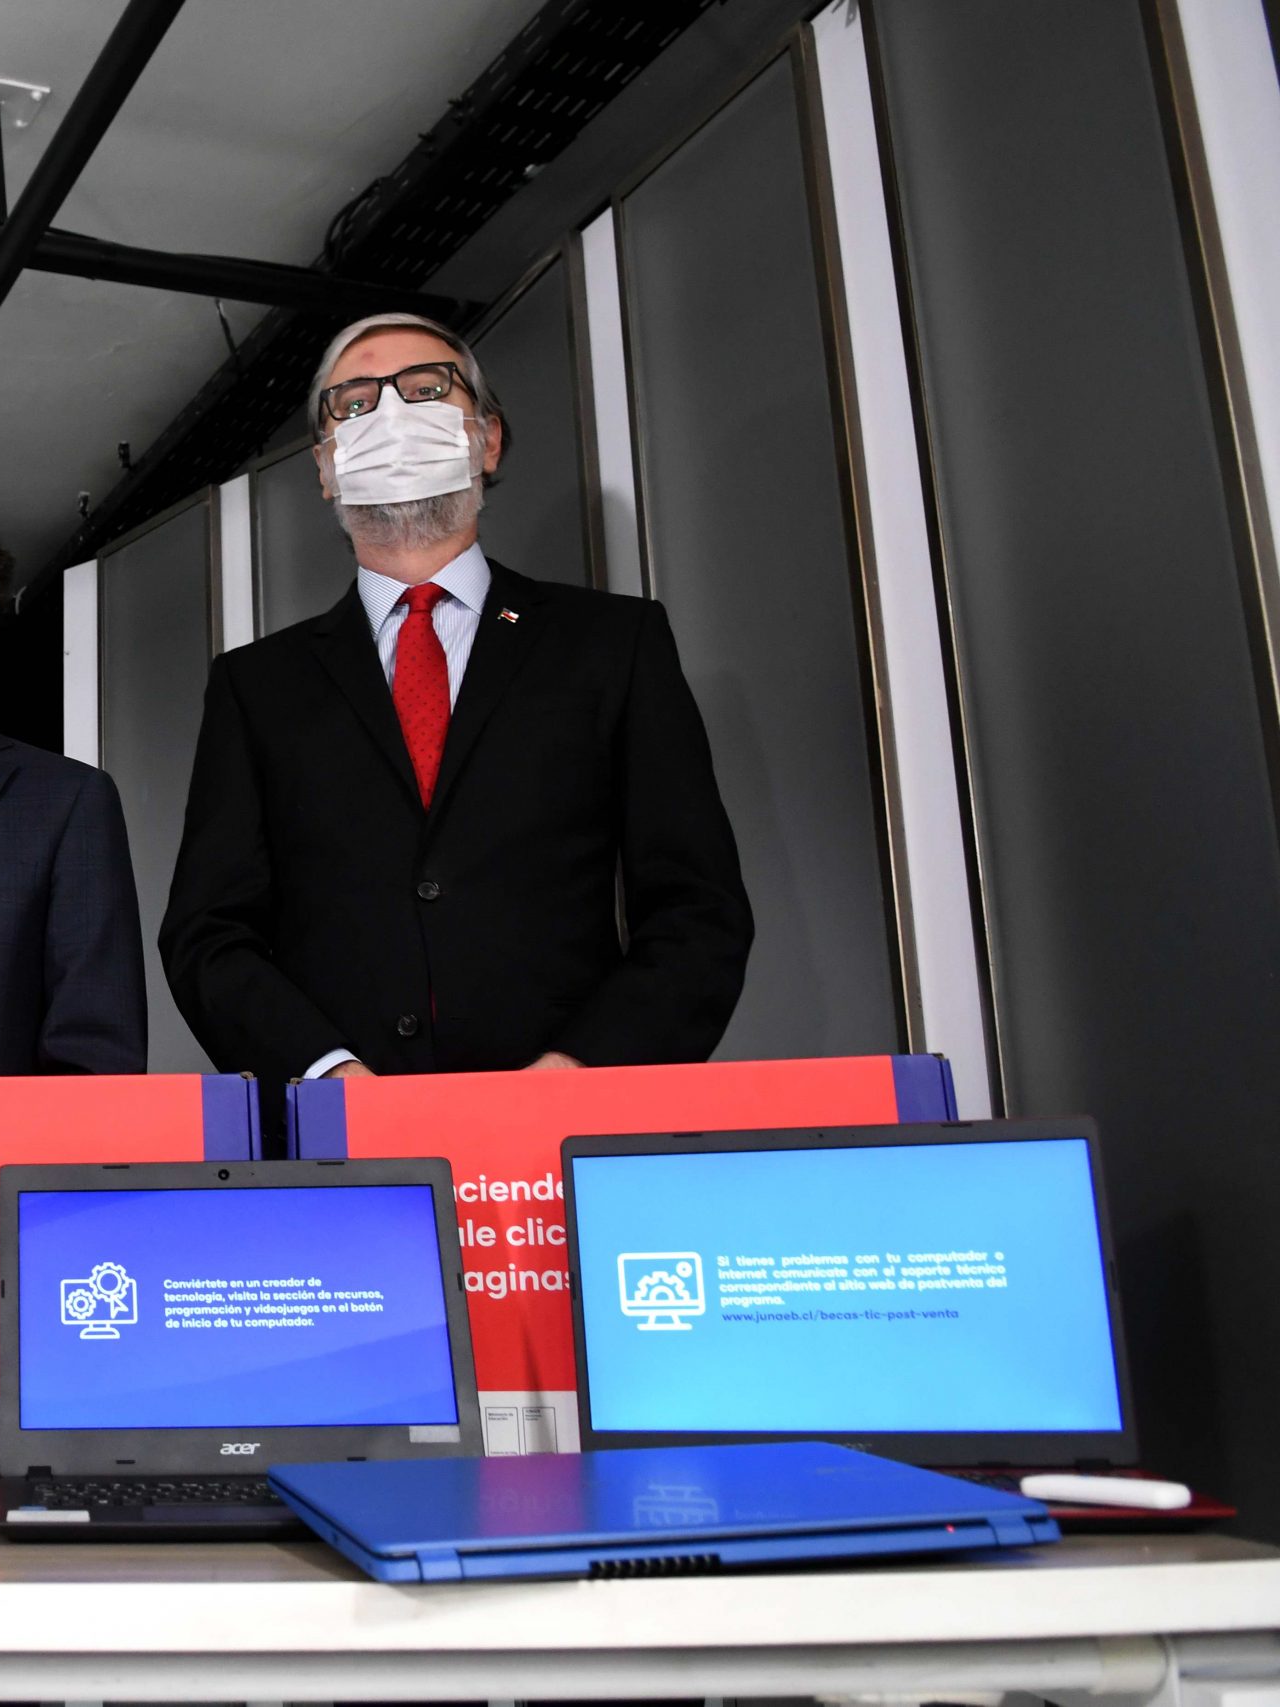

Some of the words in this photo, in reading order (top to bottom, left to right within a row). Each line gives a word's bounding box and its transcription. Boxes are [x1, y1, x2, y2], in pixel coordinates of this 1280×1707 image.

[506, 1217, 567, 1246] clic
[735, 1255, 775, 1266] tienes
[781, 1254, 849, 1268] problemas
[855, 1254, 880, 1264] con
[885, 1252, 901, 1263] tu
[907, 1250, 988, 1264] computador
[994, 1251, 1005, 1261] o
[852, 1267, 878, 1277] con
[882, 1265, 895, 1277] el
[900, 1264, 951, 1278] soporte
[956, 1263, 1006, 1275] técnico
[163, 1278, 228, 1289] Conviértete
[230, 1279, 244, 1288] en
[246, 1279, 260, 1288] un
[262, 1277, 306, 1288] creador
[307, 1276, 322, 1287] de
[719, 1280, 821, 1294] correspondiente
[823, 1279, 836, 1291] al
[838, 1278, 866, 1291] sitio
[868, 1278, 896, 1290] web
[897, 1278, 915, 1290] de
[917, 1277, 984, 1291] postventa
[986, 1276, 1008, 1288] del
[228, 1290, 258, 1301] visita
[260, 1290, 271, 1301] la
[272, 1289, 315, 1301] sección
[317, 1289, 331, 1300] de
[333, 1290, 384, 1301] recursos,
[720, 1295, 786, 1308] programa.
[164, 1304, 242, 1317] programación
[244, 1306, 251, 1316] y
[253, 1303, 320, 1316] videojuegos
[322, 1304, 336, 1313] en
[338, 1302, 349, 1312] el
[350, 1301, 384, 1312] botón
[165, 1318, 180, 1328] de
[182, 1317, 212, 1328] inicio
[213, 1317, 229, 1328] de
[230, 1318, 243, 1327] tu
[244, 1316, 315, 1329] computador.
[219, 1442, 260, 1455] acer
